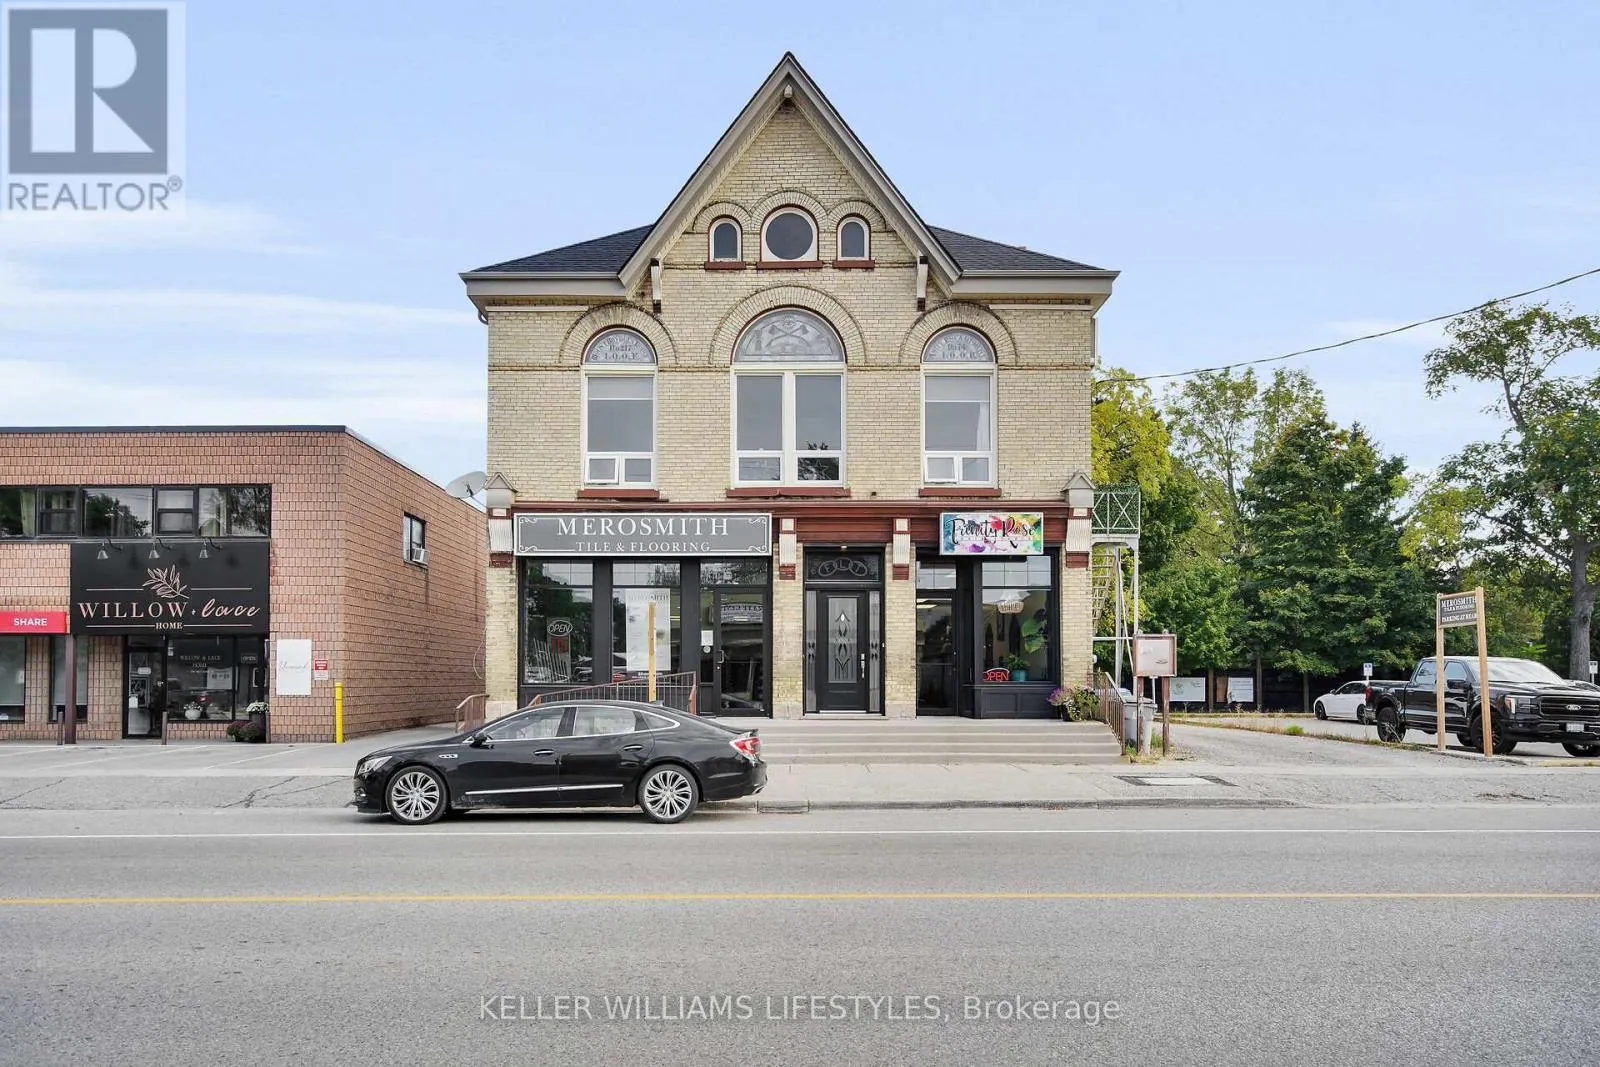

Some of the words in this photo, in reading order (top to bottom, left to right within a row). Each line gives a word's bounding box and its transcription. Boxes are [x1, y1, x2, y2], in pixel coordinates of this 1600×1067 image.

[557, 517, 729, 536] MEROSMITH
[1002, 516, 1036, 549] Rose
[575, 542, 611, 552] TILE
[616, 542, 625, 552] &
[631, 541, 711, 552] FLOORING
[78, 602, 188, 618] WILLOW
[201, 598, 261, 618] lace
[13, 617, 48, 627] SHARE
[155, 621, 184, 630] HOME
[549, 623, 571, 633] OPEN
[983, 671, 1009, 681] OPEN
